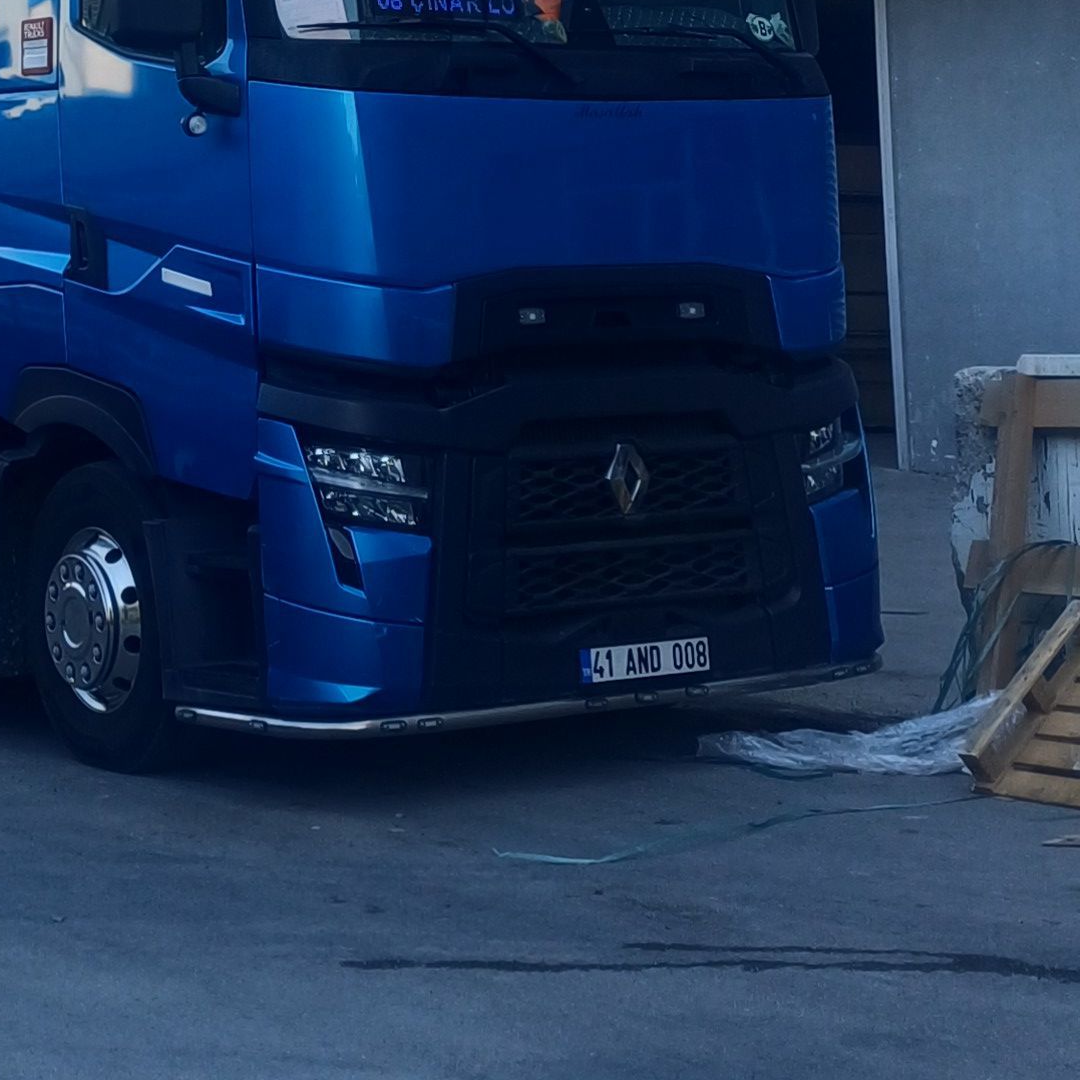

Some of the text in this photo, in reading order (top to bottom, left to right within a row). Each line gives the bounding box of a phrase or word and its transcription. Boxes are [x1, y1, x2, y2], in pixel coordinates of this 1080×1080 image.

[593, 640, 707, 678] 41 AND 008
